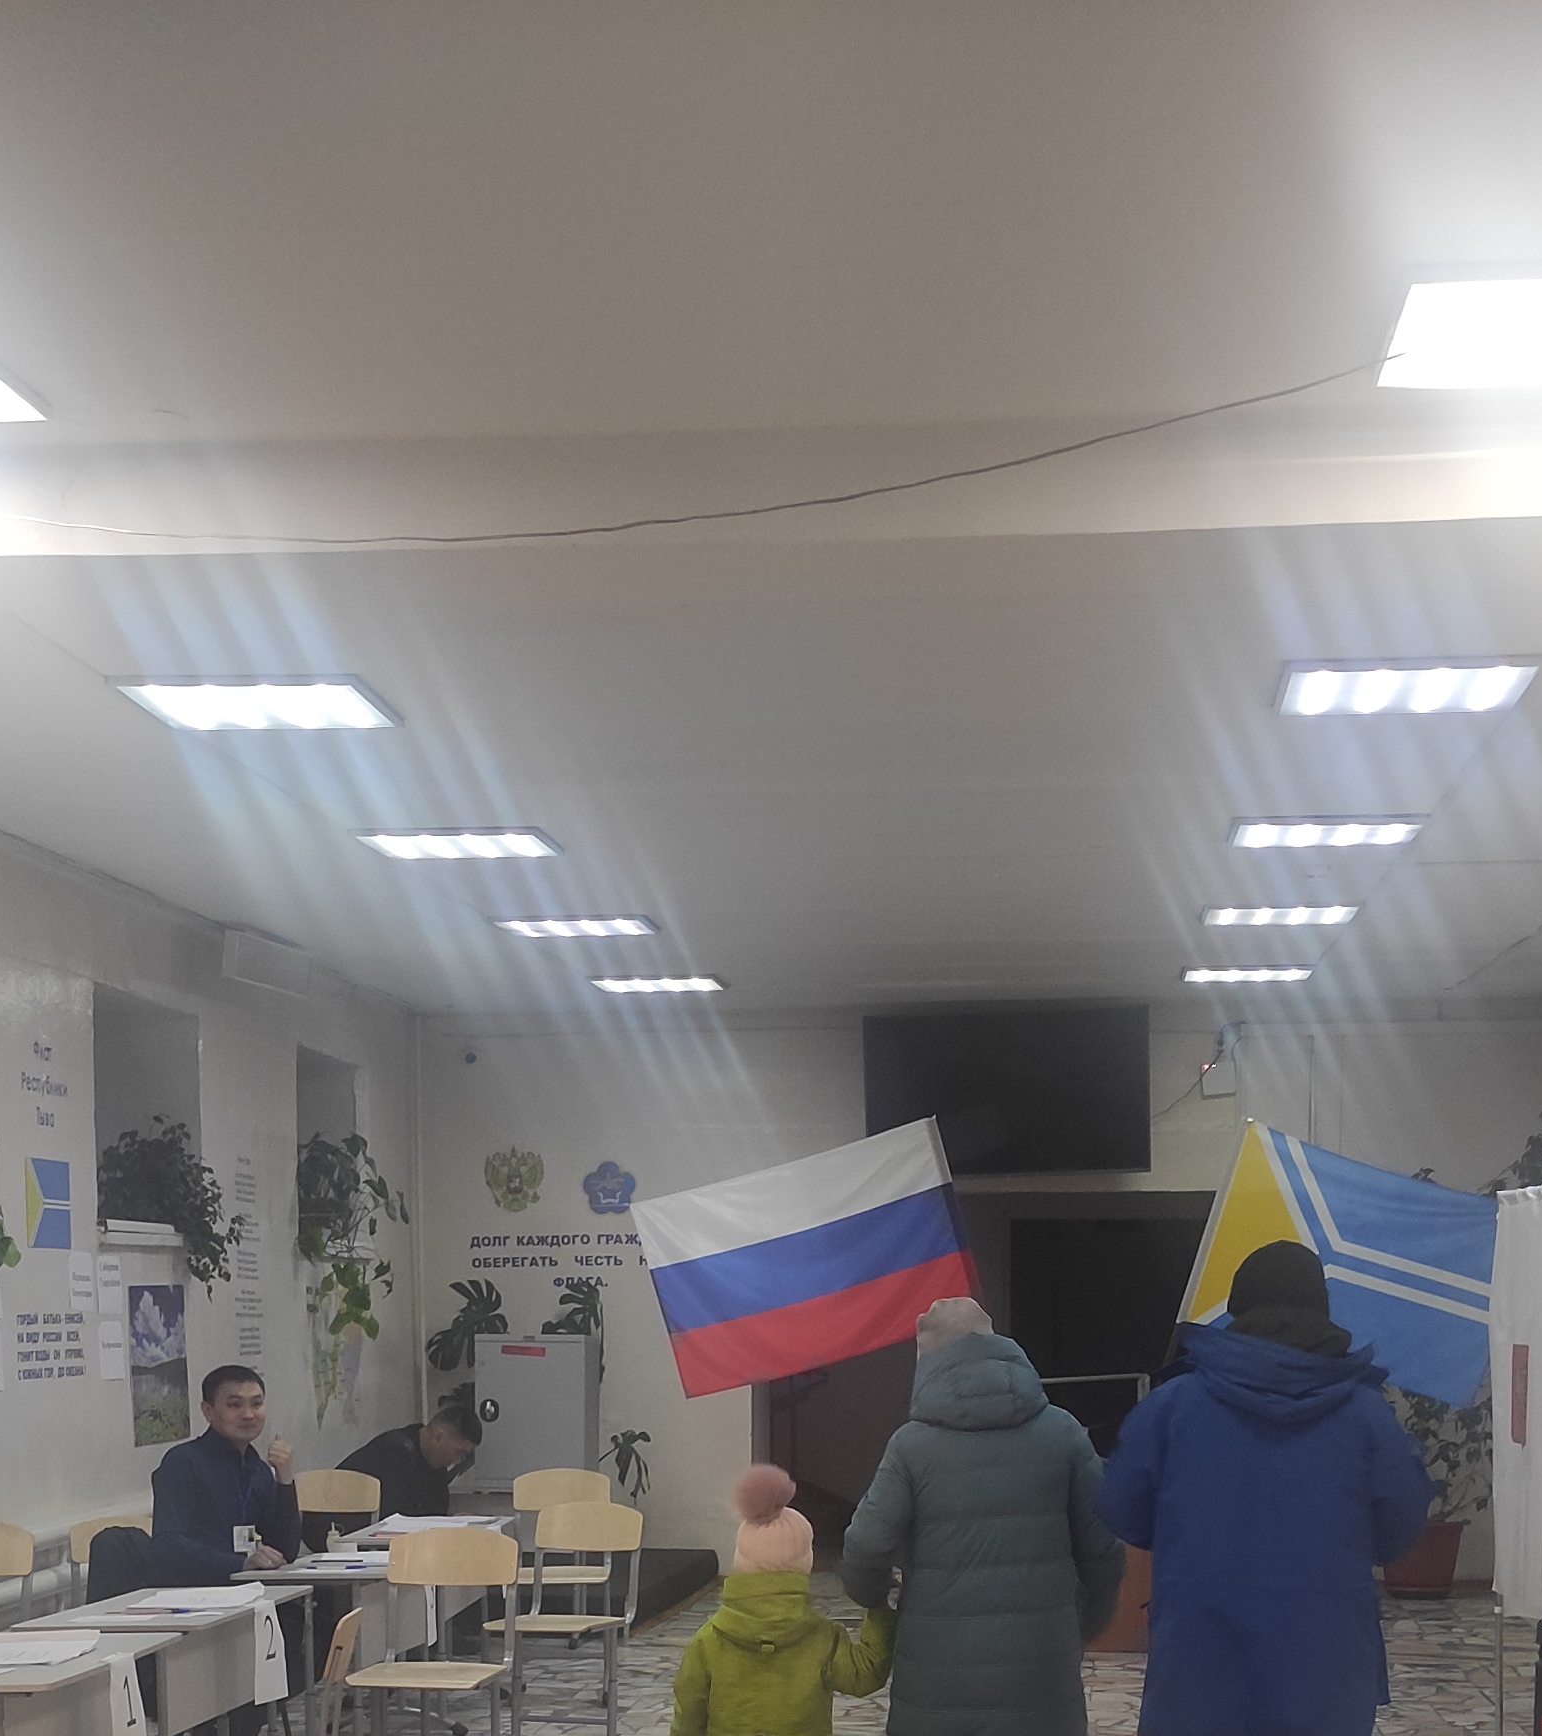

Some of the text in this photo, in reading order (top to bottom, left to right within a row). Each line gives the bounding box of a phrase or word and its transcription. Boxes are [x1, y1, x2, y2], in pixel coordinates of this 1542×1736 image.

[470, 1233, 642, 1249] ДОЛГ КАЖДОГО ГРАЖ
[471, 1255, 623, 1268] ОБЕРЕГАТЬ ЧЕСТЬ
[263, 1615, 277, 1661] 2
[123, 1675, 137, 1728] 1
